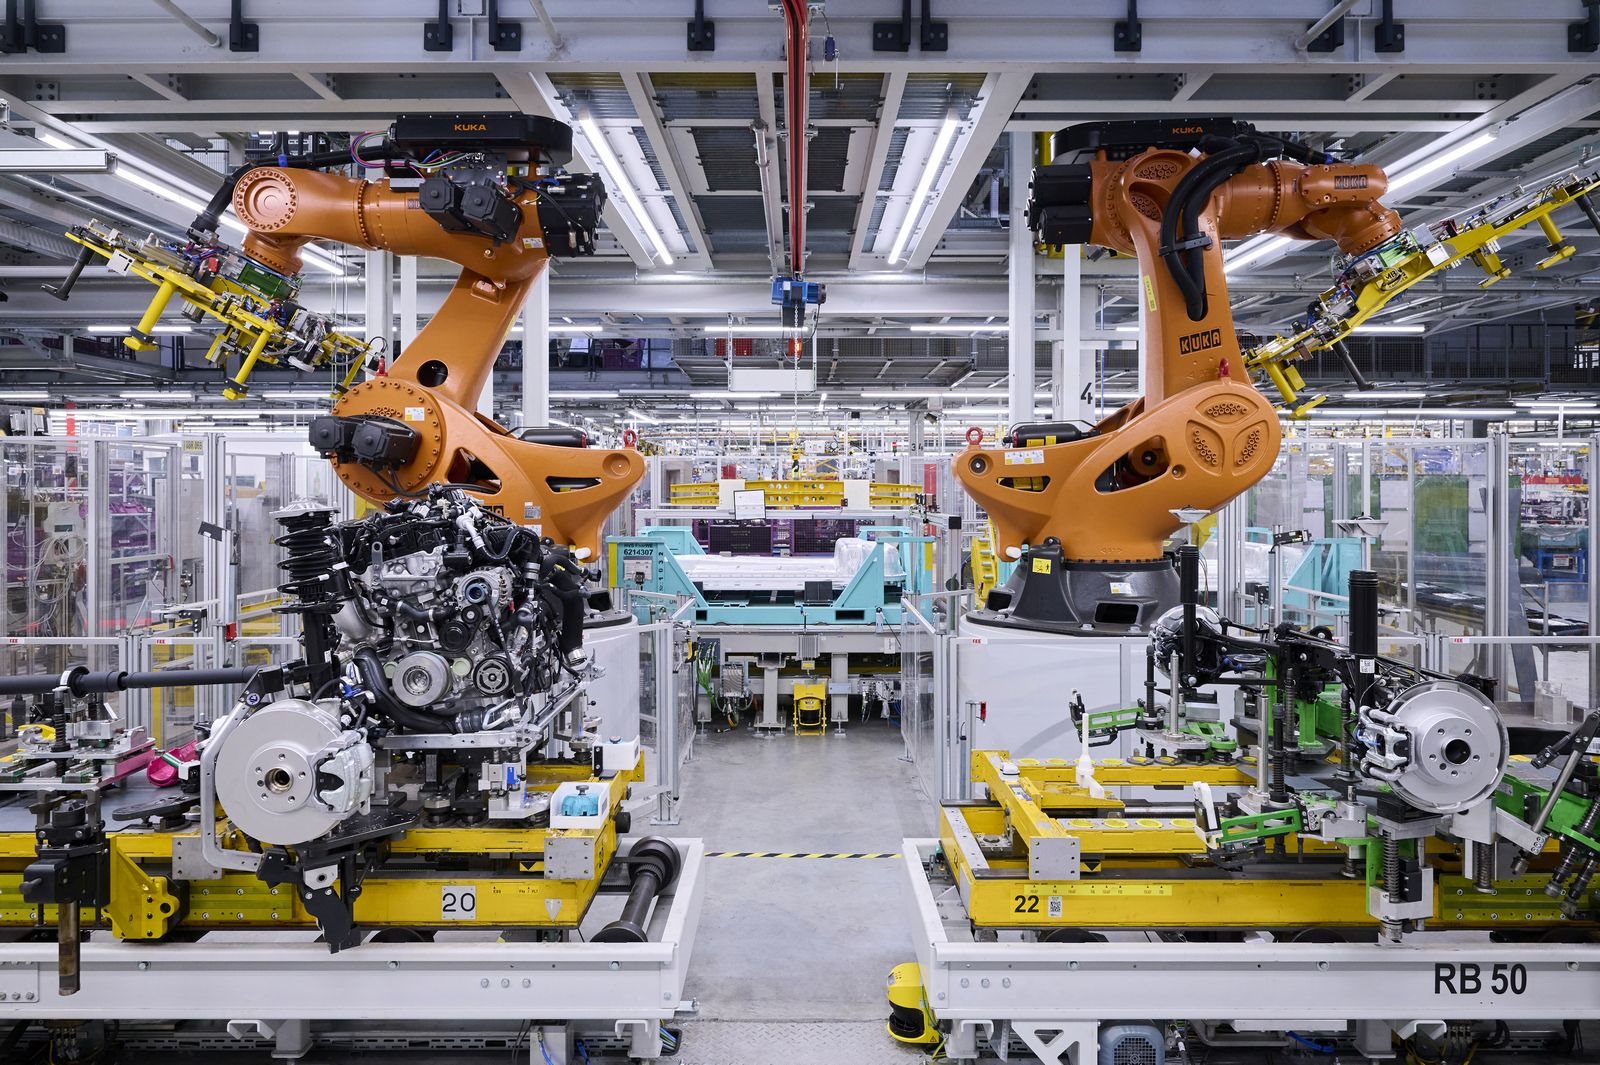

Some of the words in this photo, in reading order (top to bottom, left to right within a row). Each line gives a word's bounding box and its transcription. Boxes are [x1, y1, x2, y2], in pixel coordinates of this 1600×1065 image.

[1334, 176, 1367, 188] KUKA
[1180, 329, 1221, 354] KUKA
[1081, 382, 1093, 404] 4
[623, 548, 654, 556] 6214307
[442, 892, 475, 912] 20
[1014, 895, 1040, 913] 22
[1434, 963, 1482, 994] RB
[1491, 963, 1527, 995] 50
